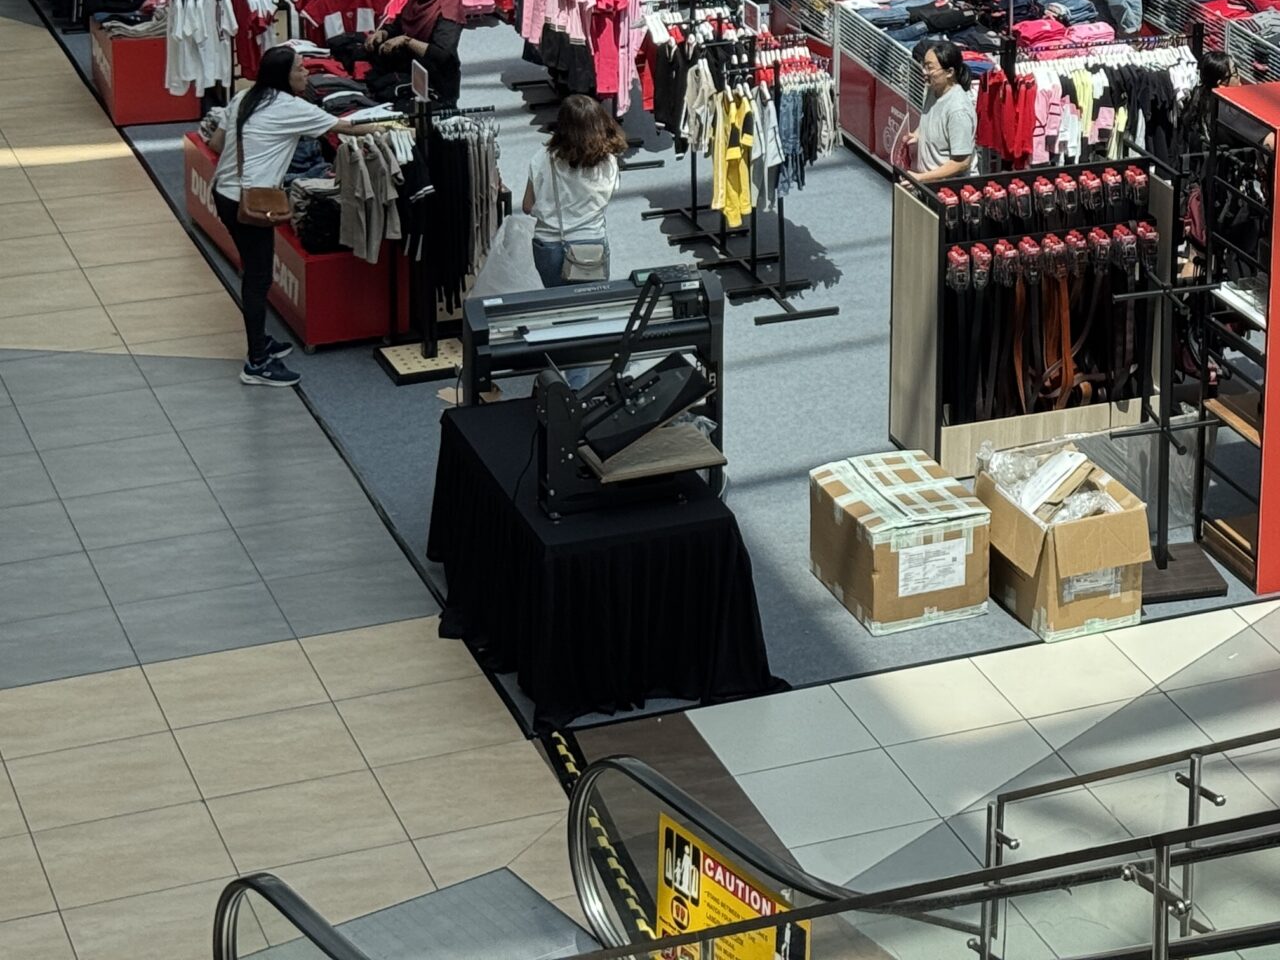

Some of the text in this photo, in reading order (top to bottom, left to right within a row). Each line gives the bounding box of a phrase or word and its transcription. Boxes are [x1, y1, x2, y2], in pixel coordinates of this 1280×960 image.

[191, 167, 218, 217] DUC
[273, 253, 300, 307] CATI
[704, 856, 772, 917] CAUTION
